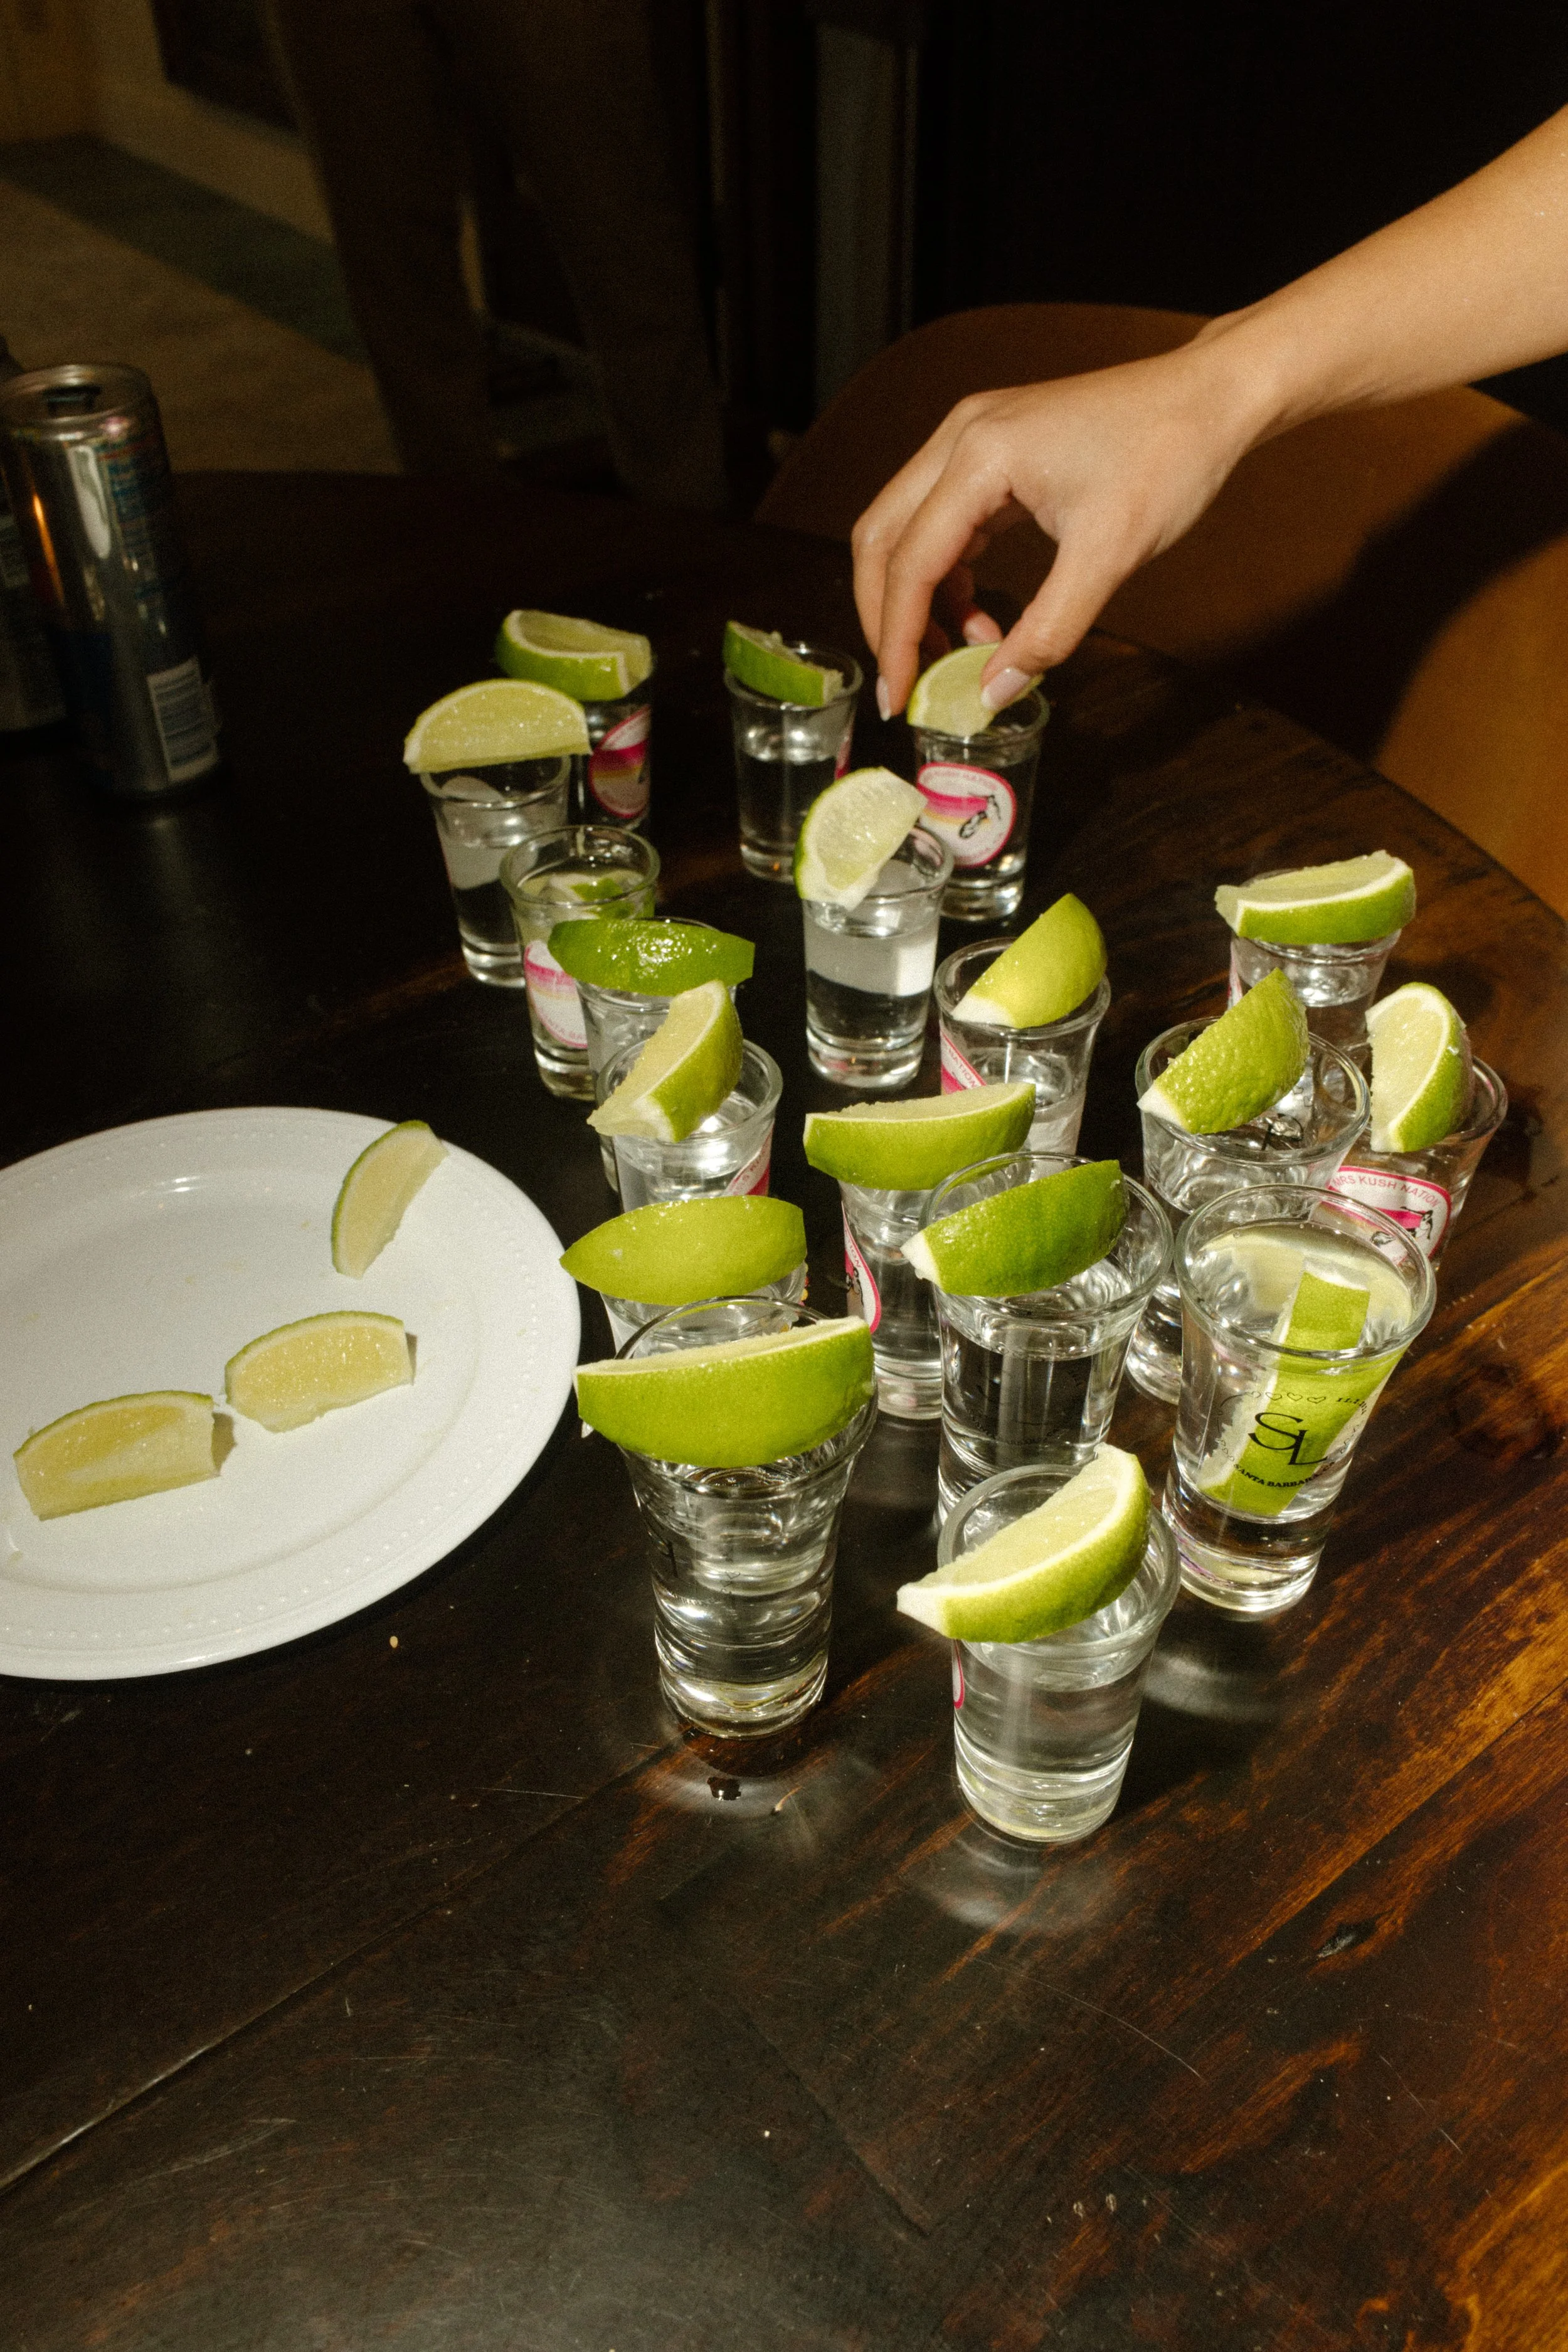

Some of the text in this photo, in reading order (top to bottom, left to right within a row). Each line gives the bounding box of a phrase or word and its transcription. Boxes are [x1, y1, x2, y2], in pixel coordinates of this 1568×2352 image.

[1359, 1175, 1397, 1190] KUSH
[1400, 1183, 1441, 1208] NATION
[1233, 1463, 1265, 1485] SANTA
